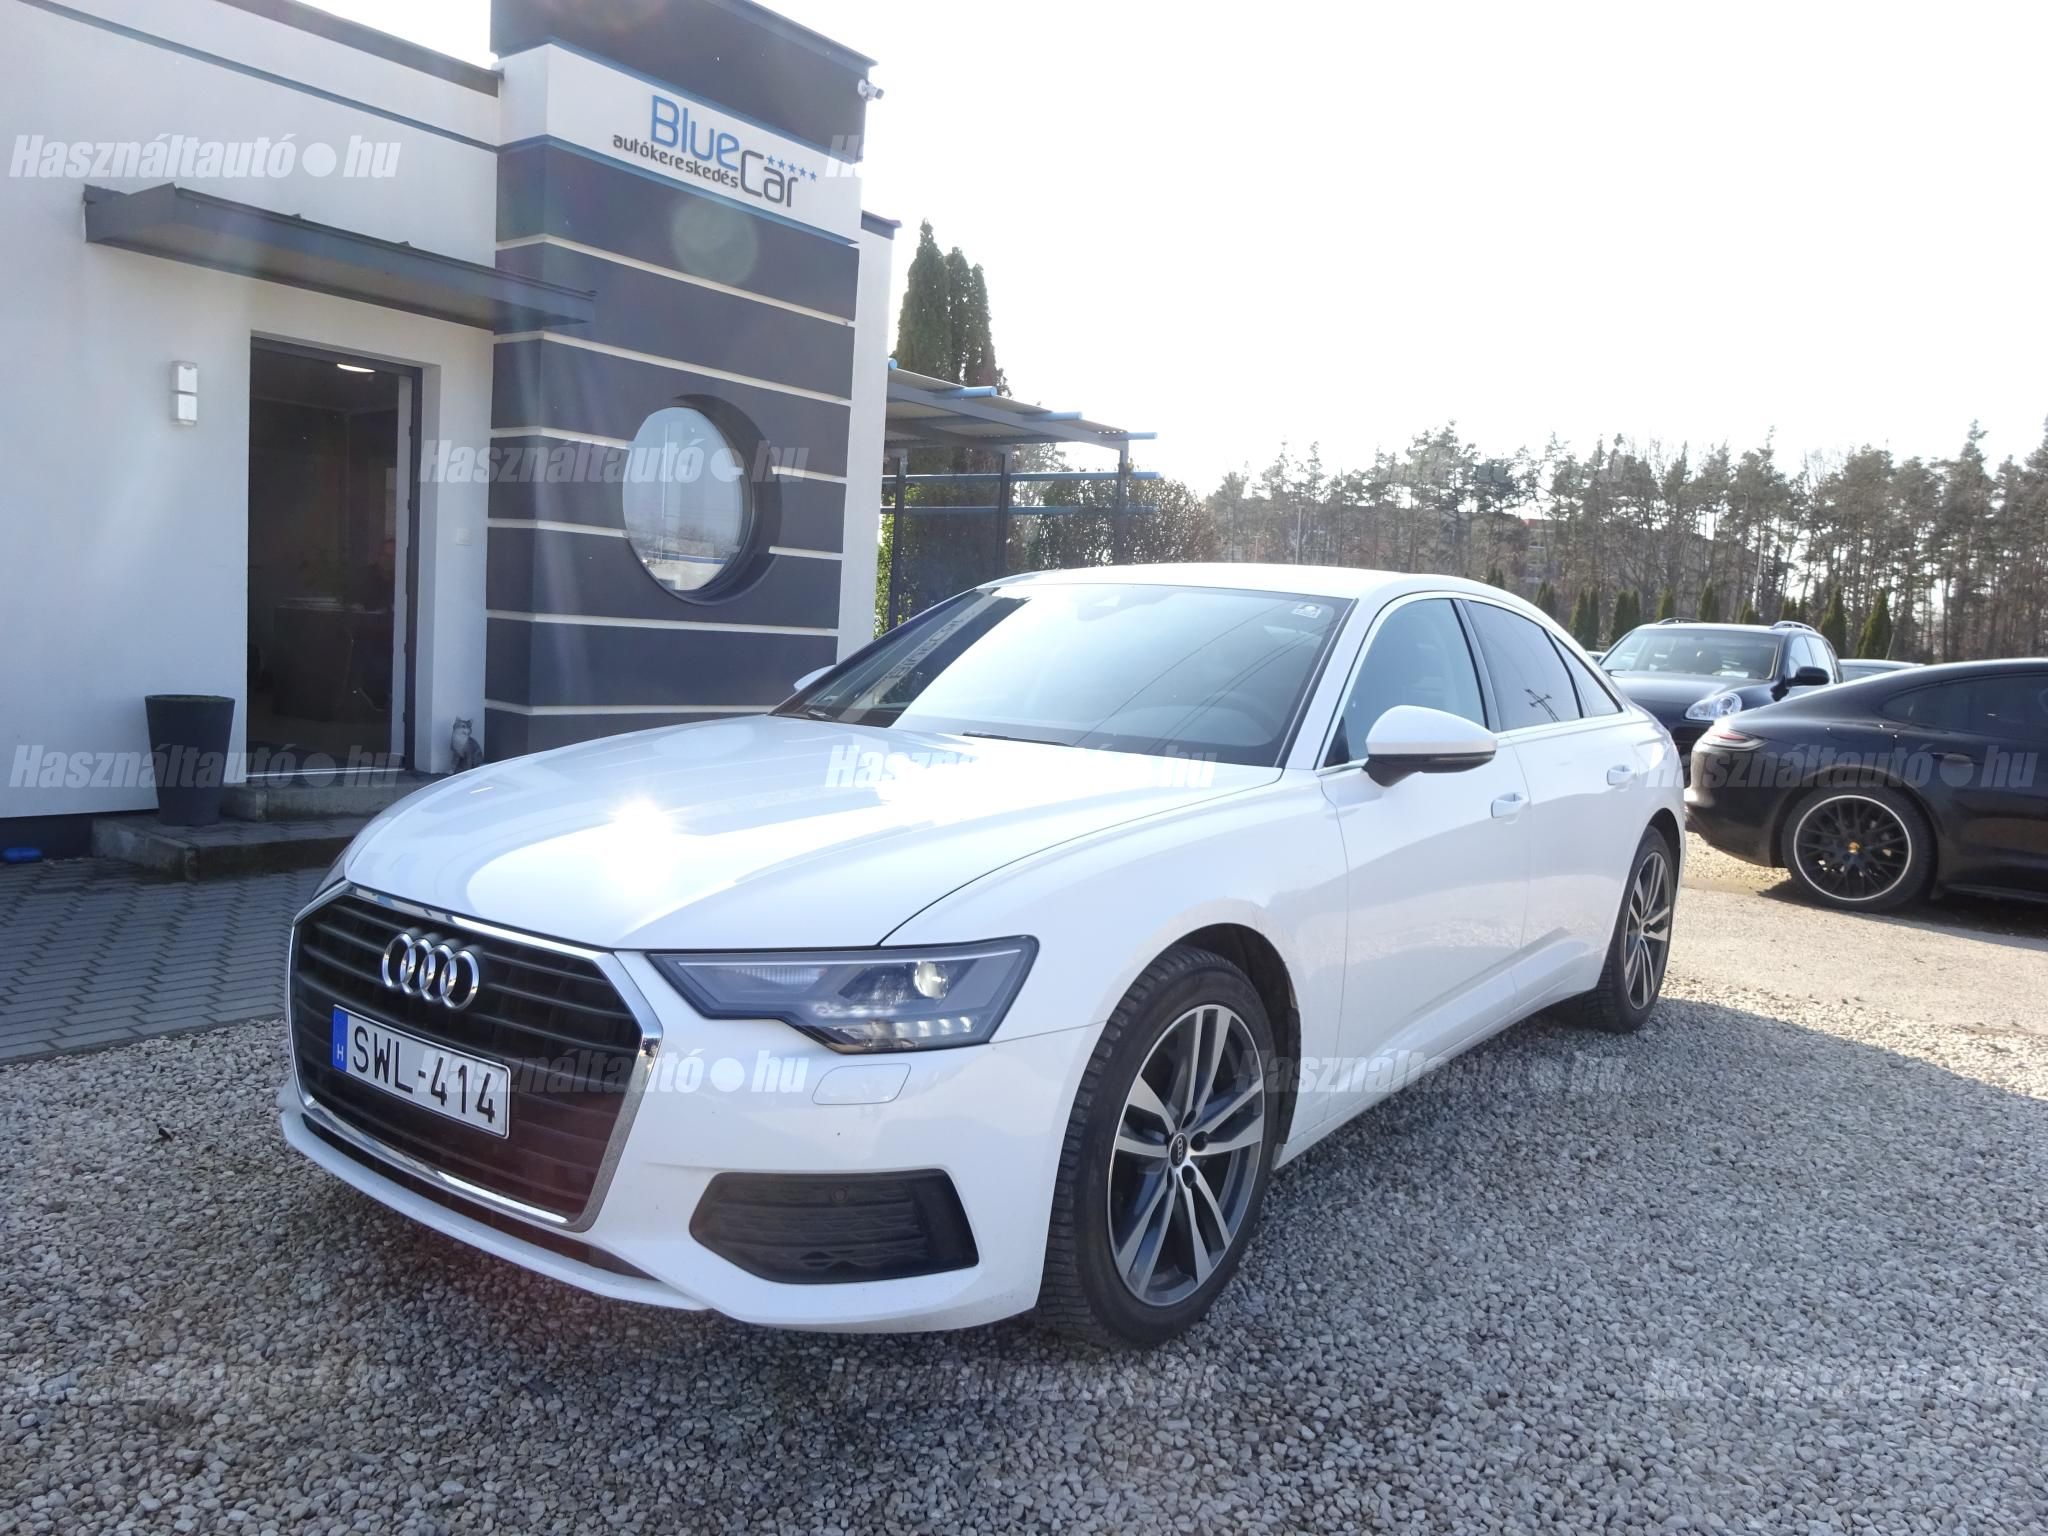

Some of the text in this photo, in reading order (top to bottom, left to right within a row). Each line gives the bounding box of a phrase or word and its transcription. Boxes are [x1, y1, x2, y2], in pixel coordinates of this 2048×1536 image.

[613, 134, 738, 189] autókereskedés
[336, 1043, 344, 1062] H
[353, 1025, 496, 1124] SWL-414
